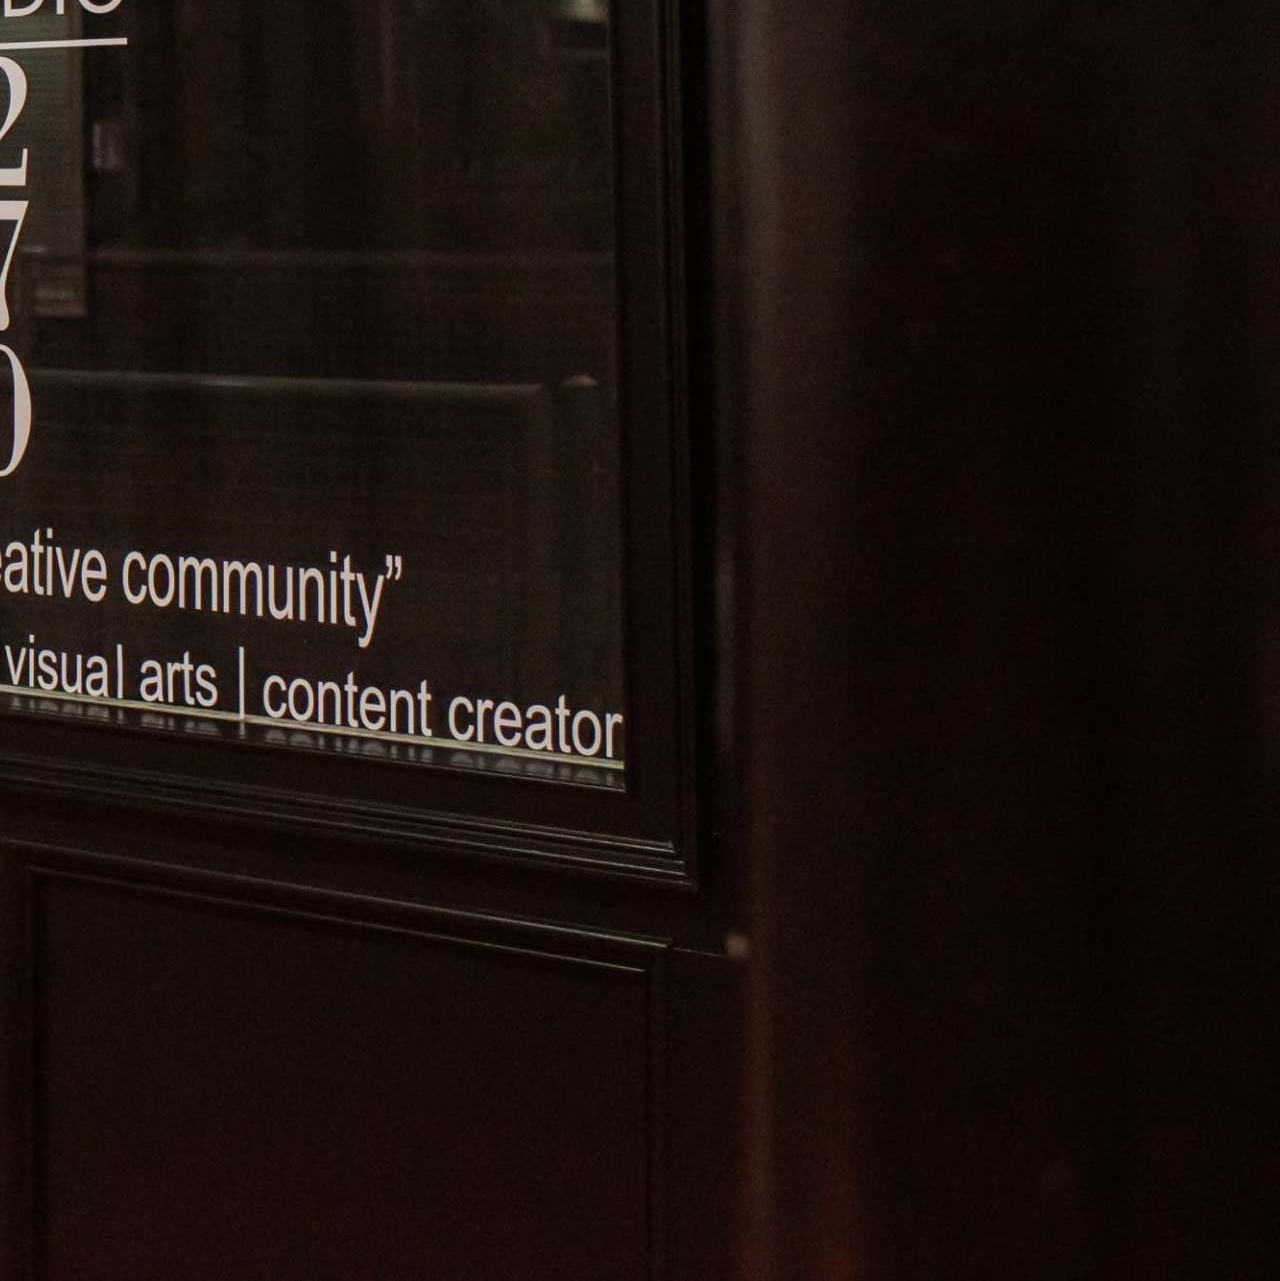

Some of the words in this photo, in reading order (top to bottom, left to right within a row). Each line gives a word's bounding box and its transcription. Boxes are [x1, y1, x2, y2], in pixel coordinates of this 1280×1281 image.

[4, 633, 124, 699] visual
[139, 651, 219, 707] arts
[262, 671, 433, 738] content
[448, 694, 624, 759] creator
